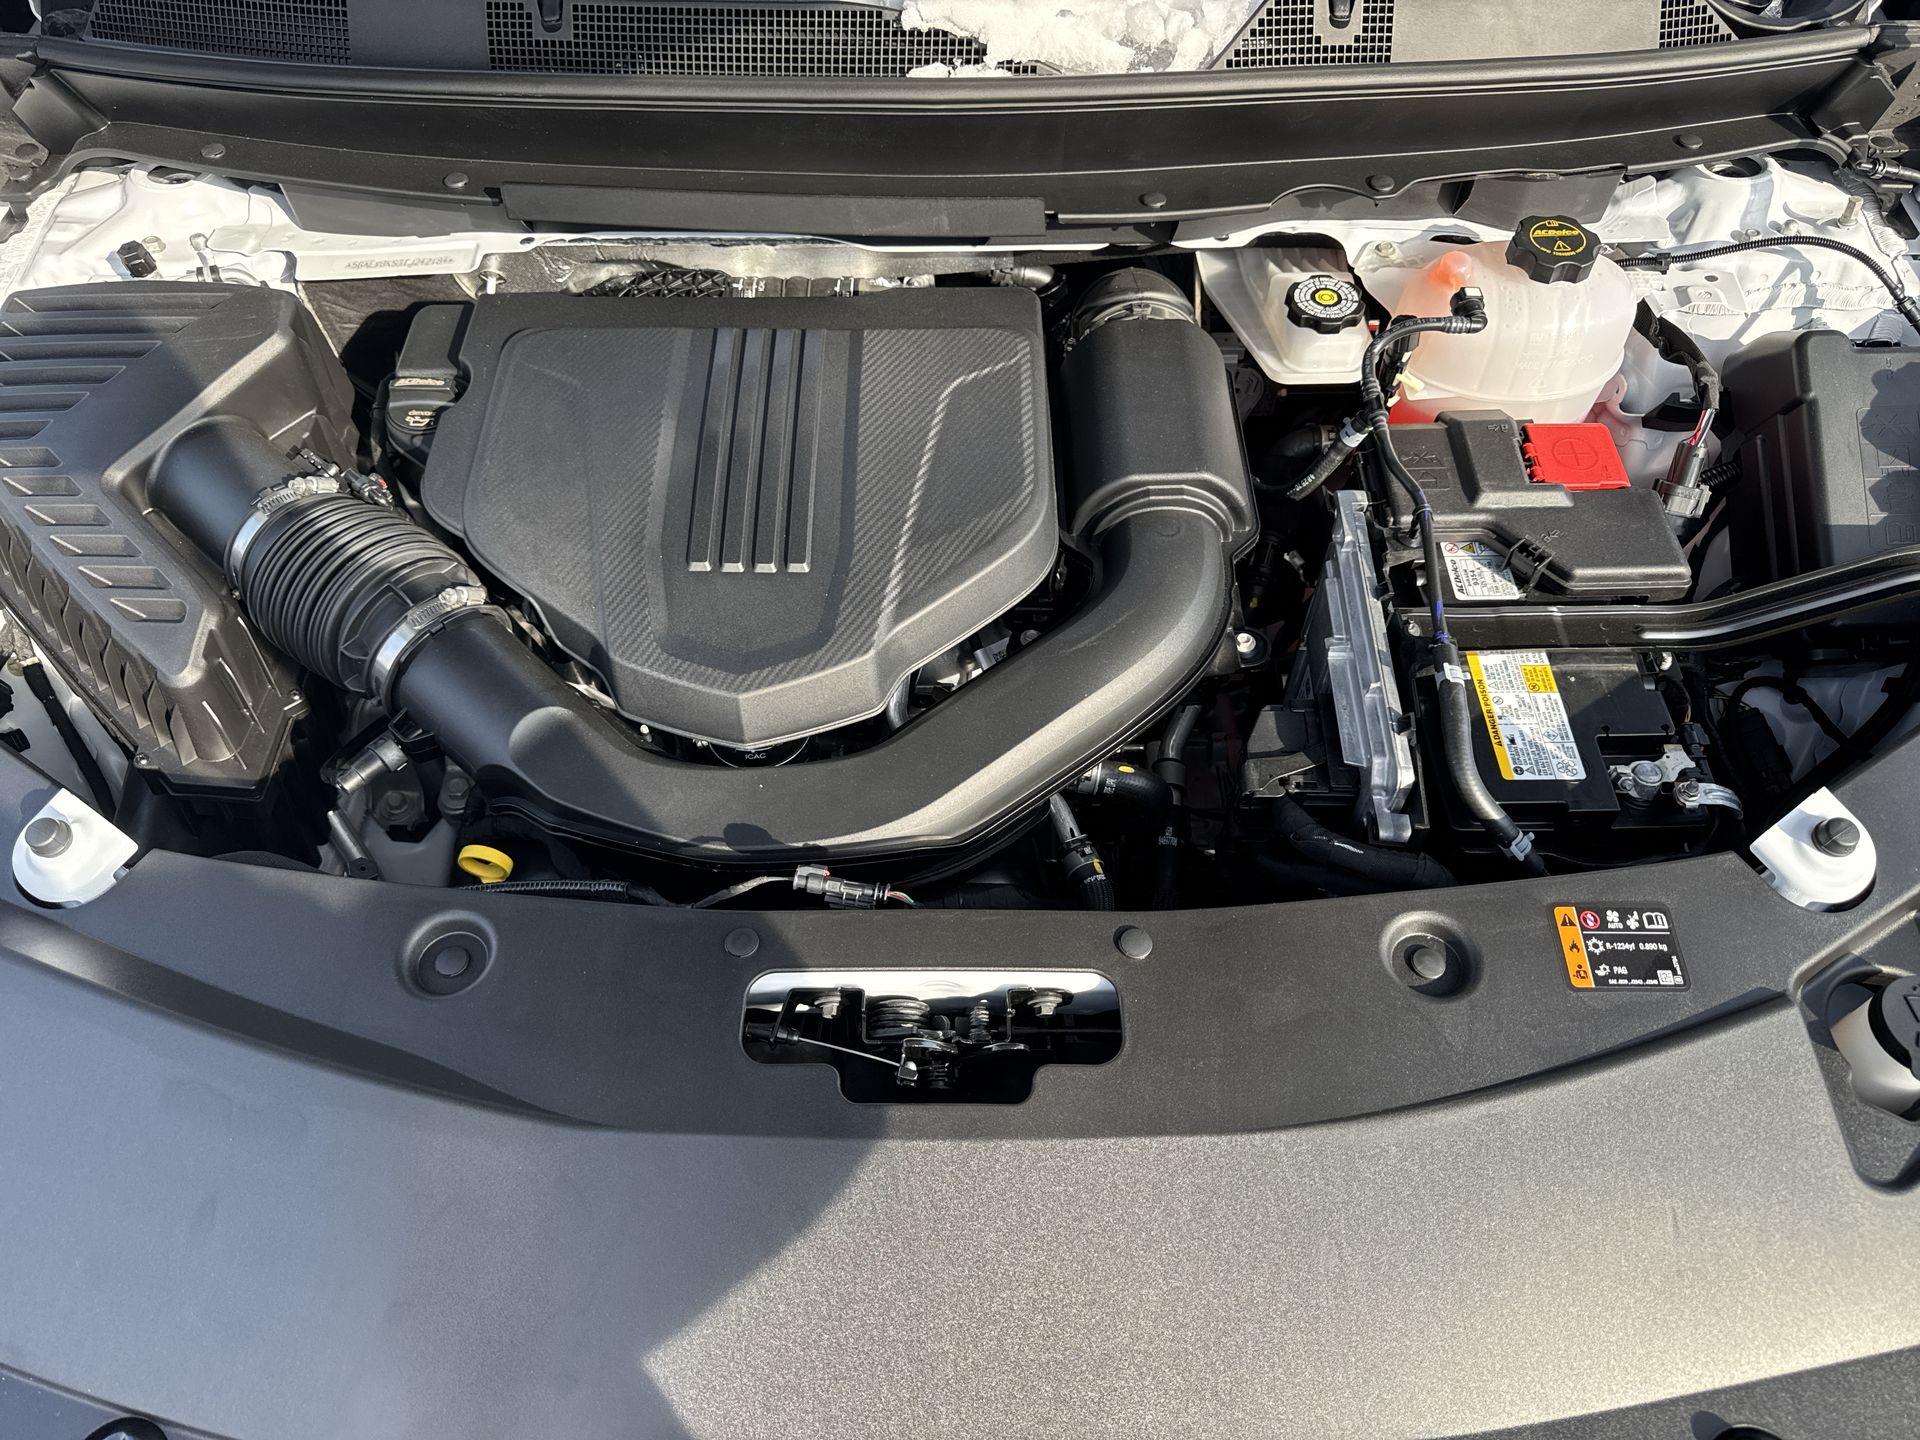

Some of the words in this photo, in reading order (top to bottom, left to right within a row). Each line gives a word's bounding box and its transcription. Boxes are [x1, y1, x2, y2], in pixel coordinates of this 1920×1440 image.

[1533, 229, 1579, 237] ACDelco
[1450, 559, 1465, 595] ACDelco
[745, 752, 766, 760] ICAC
[1658, 943, 1668, 952] kg
[1613, 966, 1628, 975] PAG
